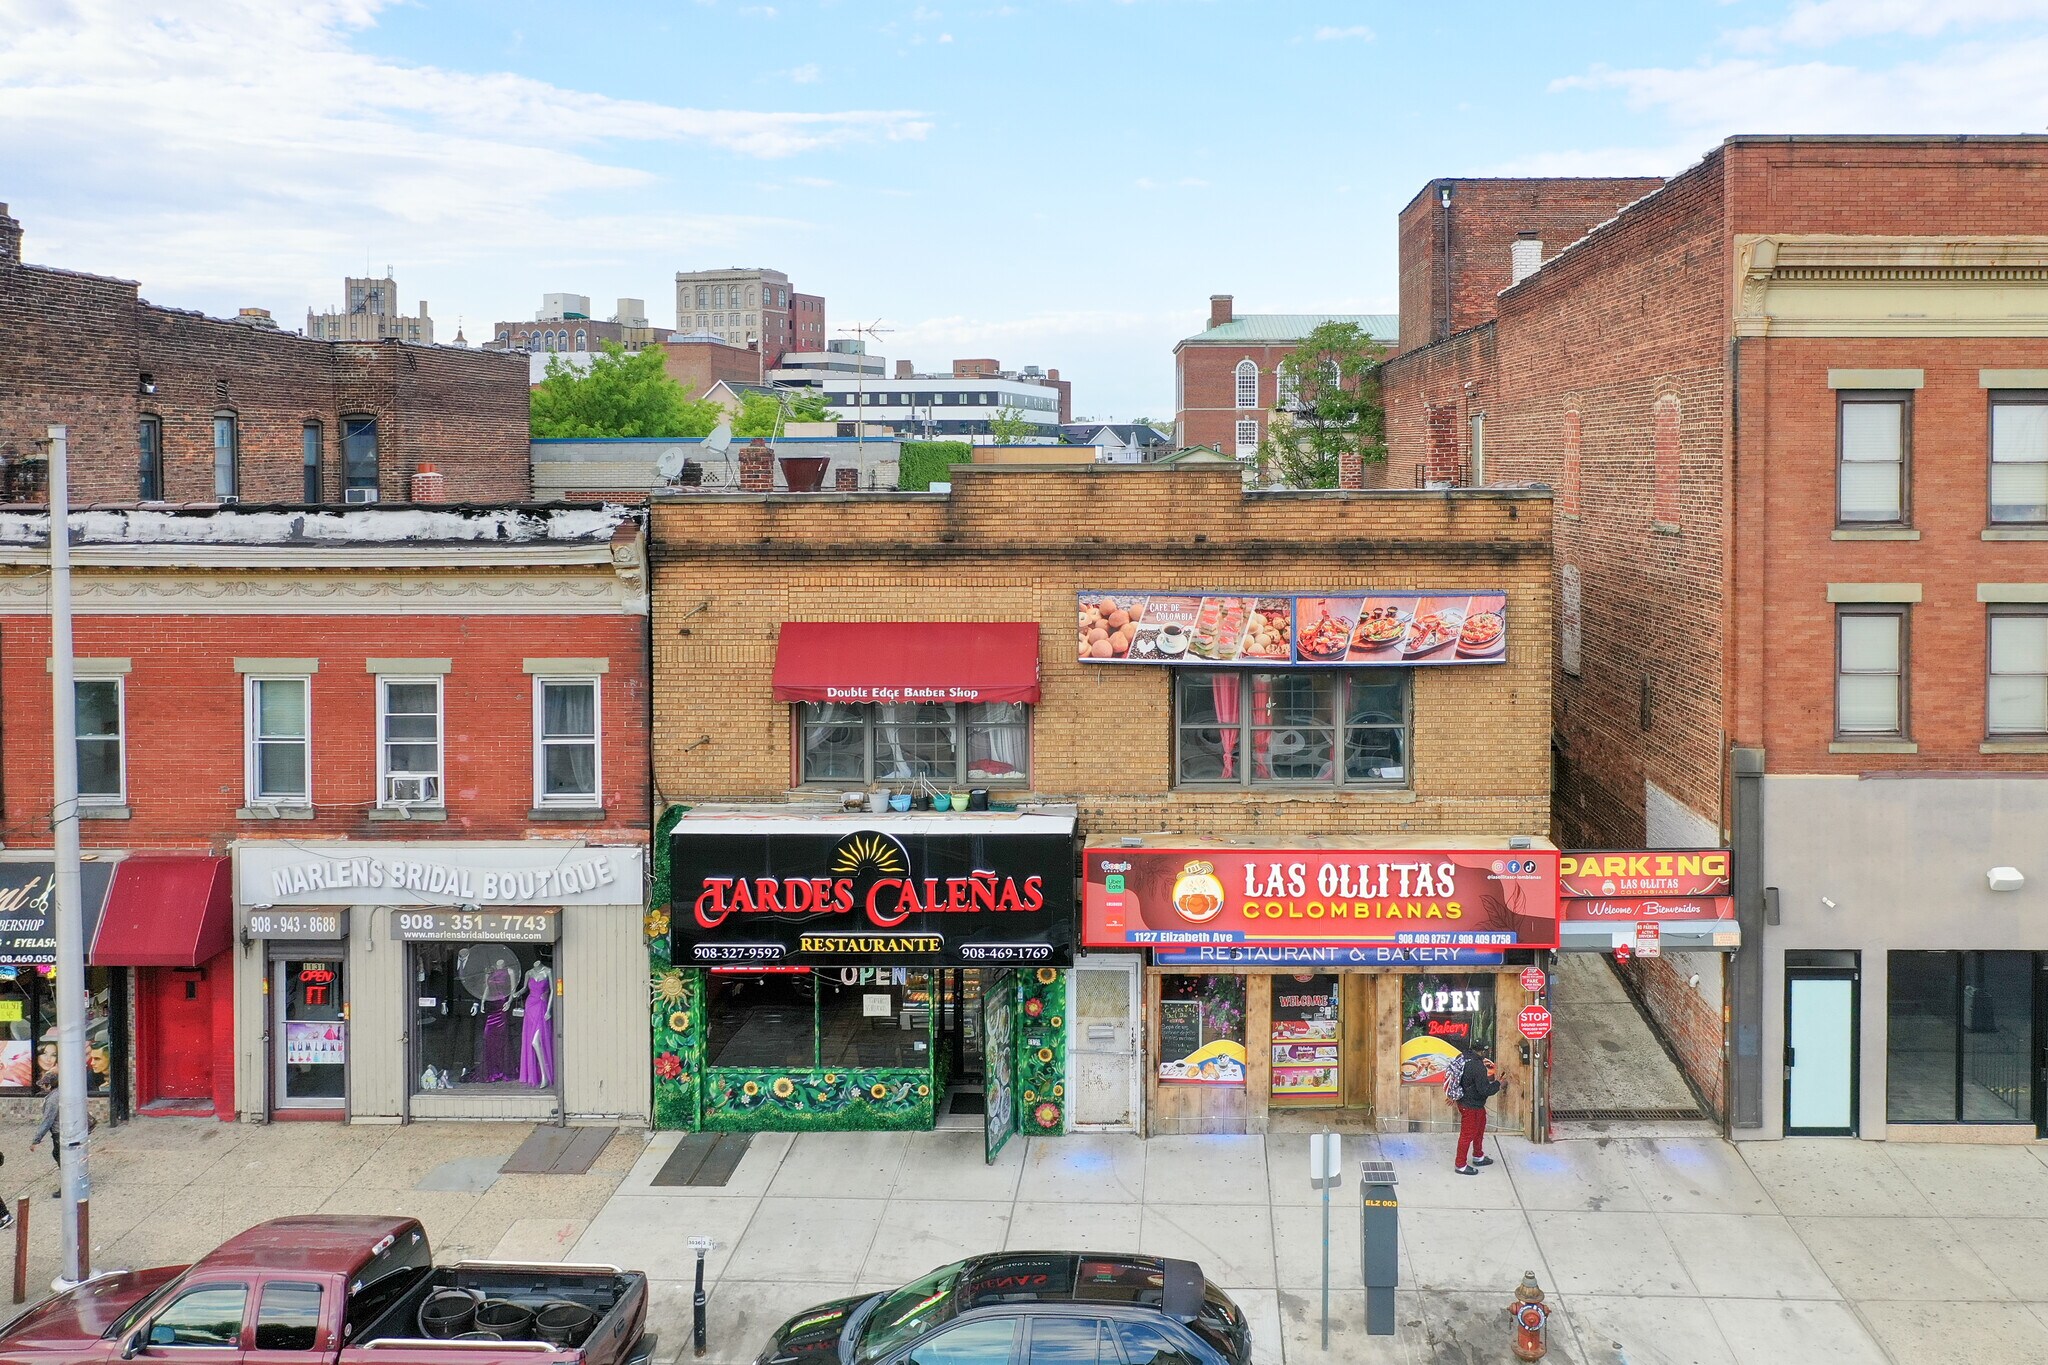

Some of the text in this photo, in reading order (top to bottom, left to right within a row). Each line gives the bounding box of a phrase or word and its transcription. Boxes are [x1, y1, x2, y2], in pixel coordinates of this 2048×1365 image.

[1150, 603, 1180, 612] CAFE DE
[1156, 612, 1193, 621] COLOMBIA
[827, 687, 979, 699] Double Edge Barber Shop
[1101, 861, 1132, 872] Google
[1560, 855, 1725, 877] PARKING
[391, 861, 475, 899] BRIDAL
[483, 855, 614, 900] BOUTIQUE
[1244, 862, 1456, 899] LAS OLLITAS
[1620, 879, 1679, 889] LAS OLLITAS
[694, 869, 1044, 928] TARDES CALEÑAS
[1242, 901, 1463, 919] COLOMBIANAS
[1587, 902, 1633, 916] Welcome
[1642, 901, 1701, 916] Bienvenidos
[251, 916, 271, 933] 908
[280, 917, 299, 933] 943
[309, 917, 336, 933] 8688
[400, 914, 434, 930] 908
[451, 915, 483, 930] 351
[501, 915, 547, 931] 7743
[404, 931, 542, 940] www.marlensbridalboutique.com
[1134, 932, 1233, 942] 1127 Elizabeth Ave
[1398, 934, 1413, 944] 908
[1414, 934, 1430, 944] 409
[1431, 934, 1450, 944] 8757
[1458, 934, 1473, 944] 908
[1475, 934, 1490, 944] 409
[1491, 934, 1511, 944] 8758
[800, 937, 941, 952] RESTAURANTE
[0, 954, 57, 963] 08.469.050
[694, 947, 780, 959] 908-327-9592
[962, 947, 1049, 959] 908-469-1769
[1200, 947, 1460, 961] RESTAURANT & BAKERY
[301, 971, 334, 981] OPEN
[840, 967, 906, 985] OPEN
[1279, 995, 1328, 1007] WELCOME
[1421, 991, 1480, 1012] OPEN
[1521, 1013, 1548, 1021] STOP
[1428, 1021, 1469, 1036] Bakery
